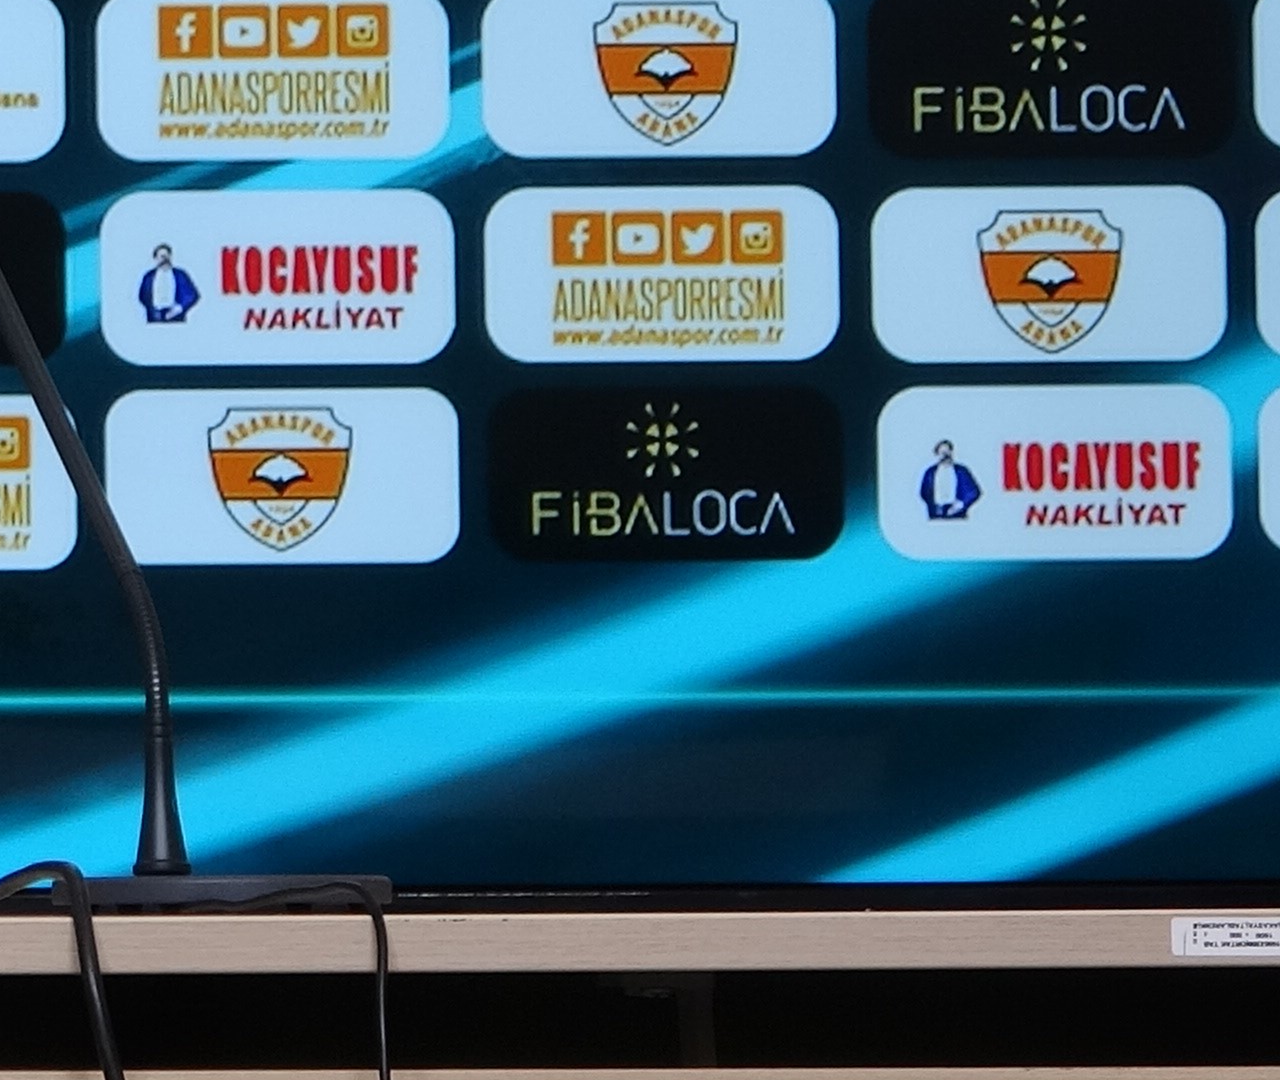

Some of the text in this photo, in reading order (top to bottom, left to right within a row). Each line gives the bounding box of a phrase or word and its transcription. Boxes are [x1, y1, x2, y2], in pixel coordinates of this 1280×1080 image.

[159, 62, 390, 119] ADANASPORRESMİ
[221, 245, 418, 296] KOCAYUSUF
[553, 267, 784, 323] ADANASPORRESMİ
[244, 300, 404, 330] NAKLİYAT
[1002, 441, 1201, 492] KOCAYUSUF
[1026, 497, 1187, 527] NAKLİYAT
